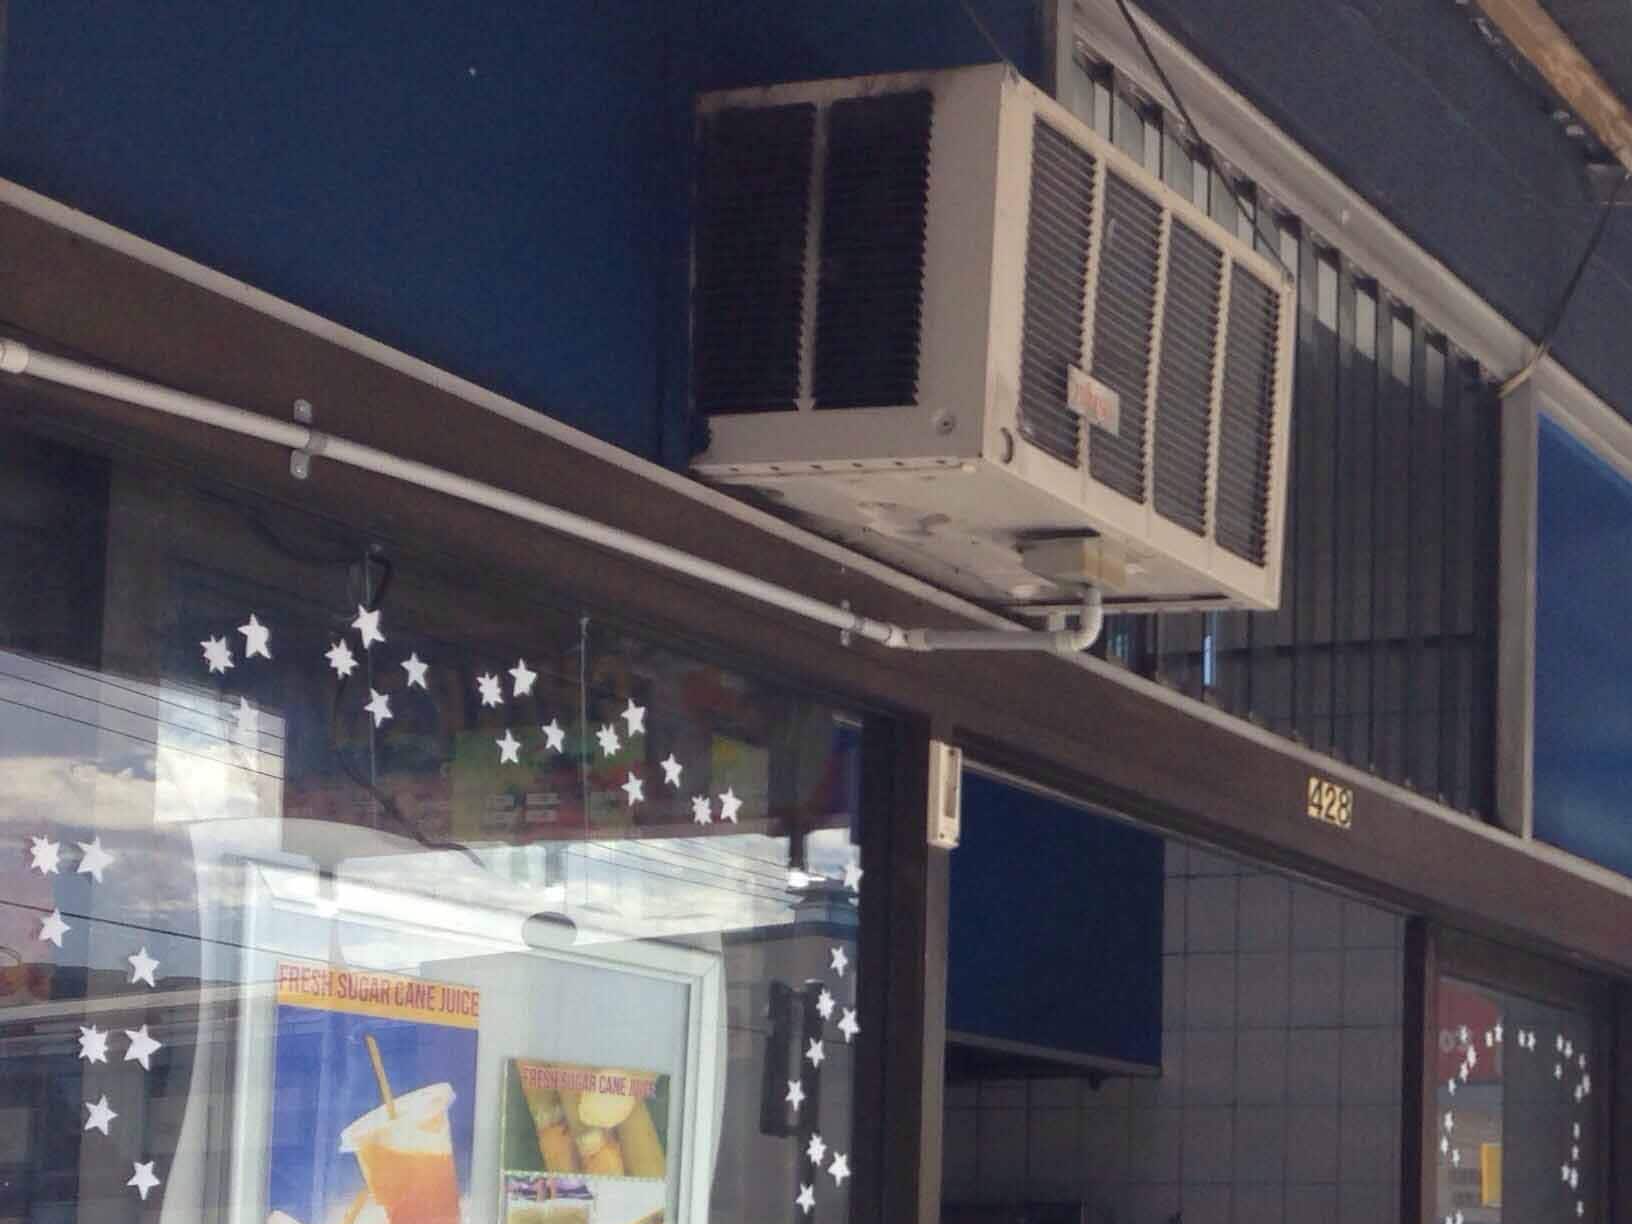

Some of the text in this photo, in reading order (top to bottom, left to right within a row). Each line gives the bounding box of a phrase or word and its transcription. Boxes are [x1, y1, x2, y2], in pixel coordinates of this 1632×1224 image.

[1311, 782, 1349, 824] 428
[279, 964, 480, 1017] FRESH SUGAR CANE JUICE
